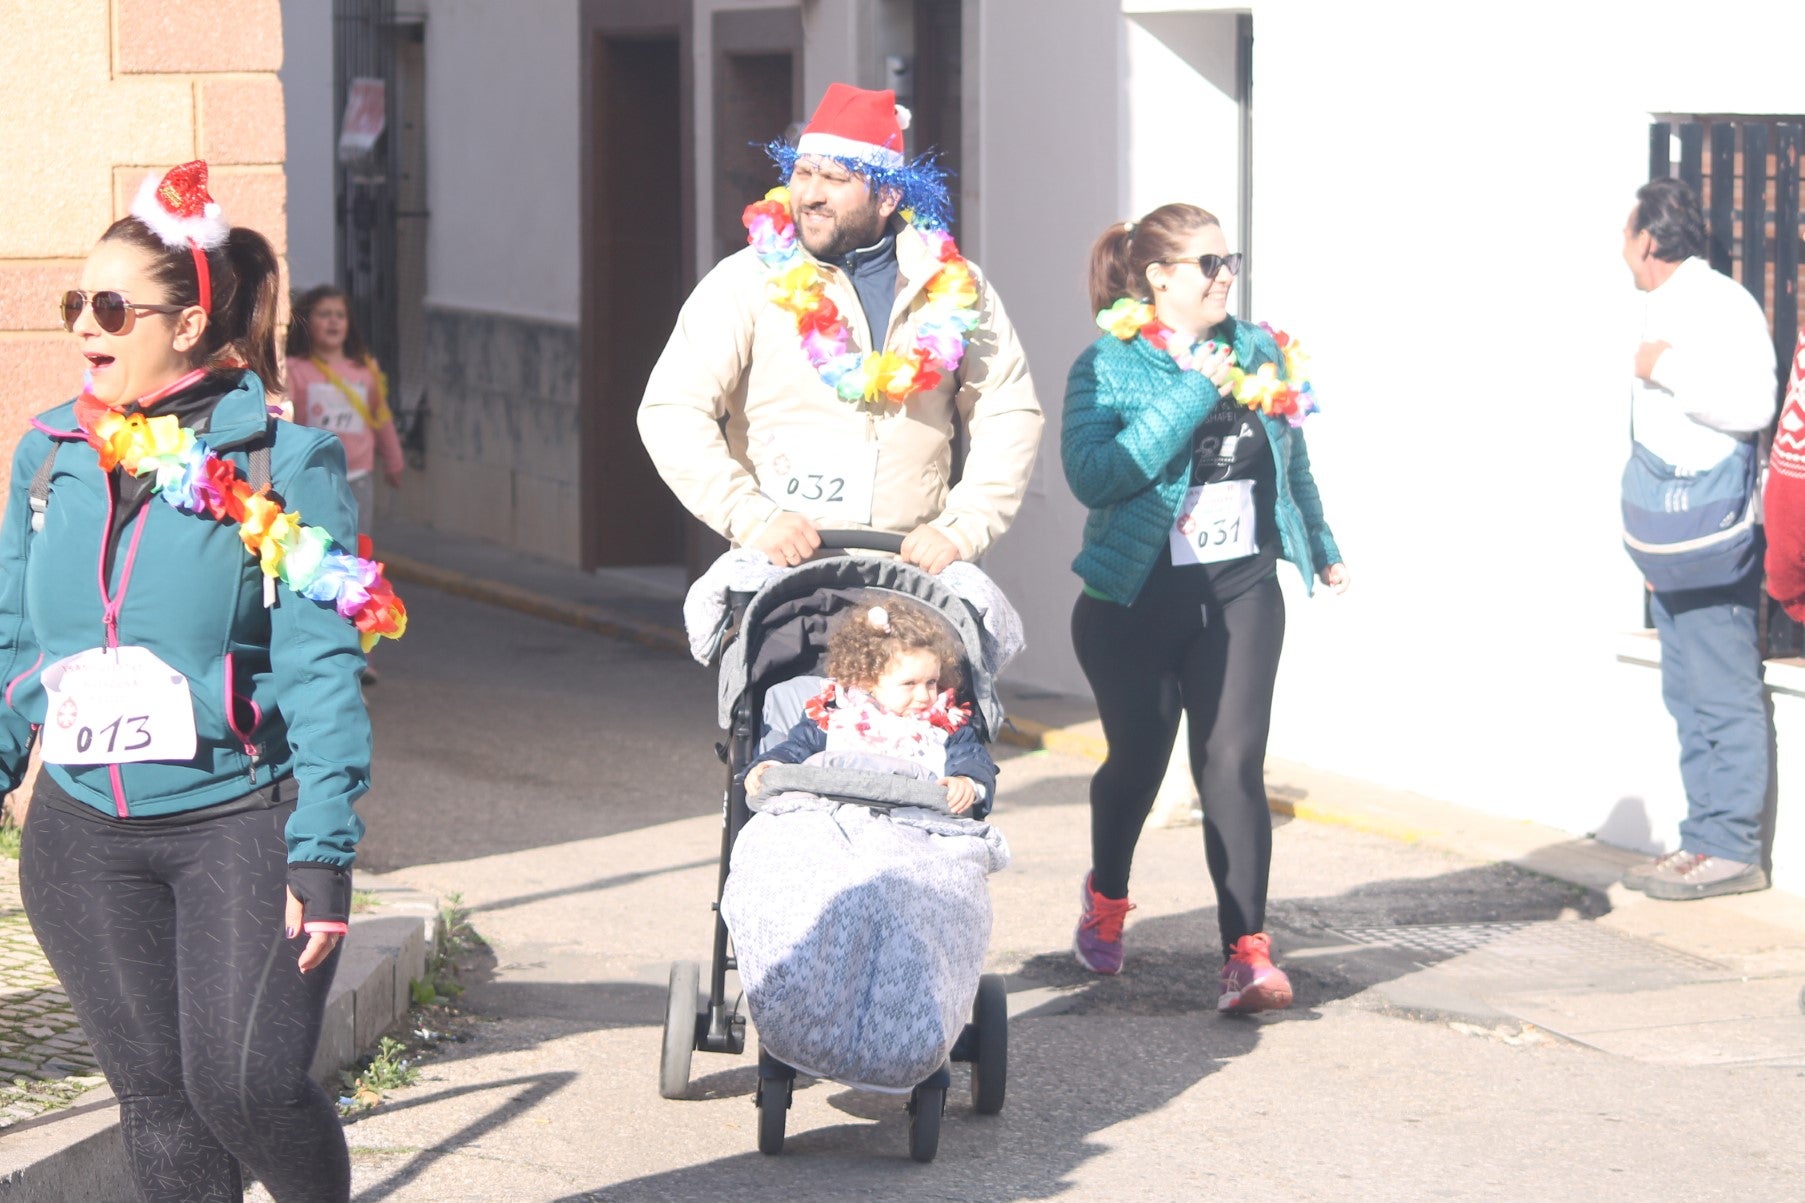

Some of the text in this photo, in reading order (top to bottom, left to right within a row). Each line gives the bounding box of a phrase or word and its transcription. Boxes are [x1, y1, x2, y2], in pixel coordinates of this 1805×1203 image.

[787, 474, 845, 502] 032
[1198, 517, 1240, 548] 031
[76, 715, 152, 753] 013
